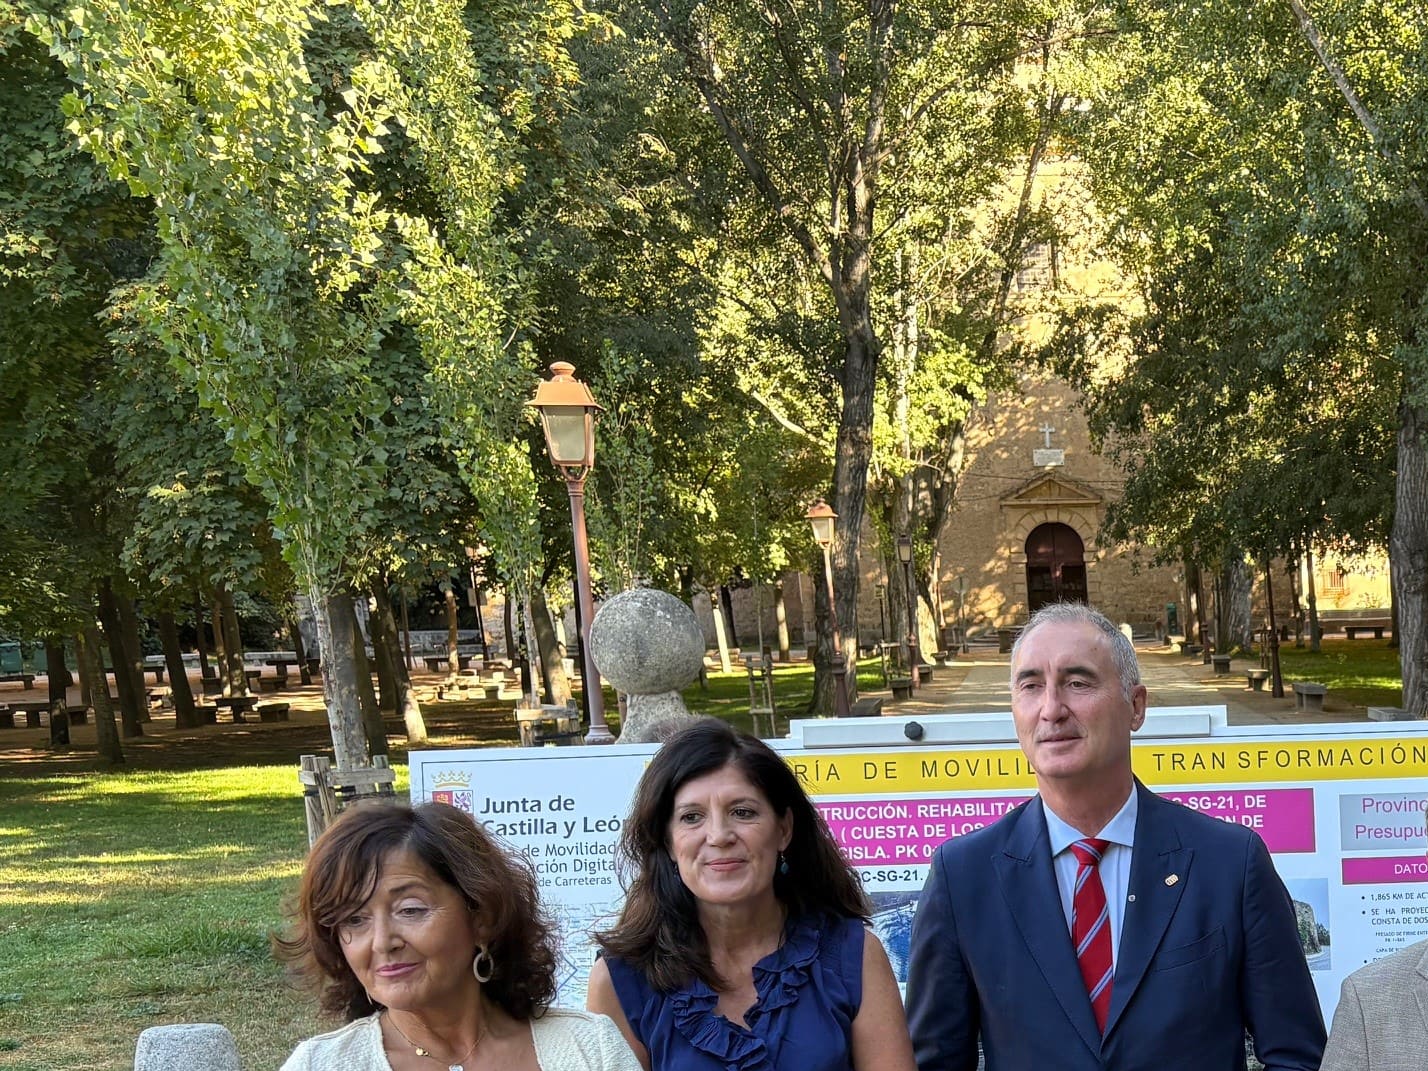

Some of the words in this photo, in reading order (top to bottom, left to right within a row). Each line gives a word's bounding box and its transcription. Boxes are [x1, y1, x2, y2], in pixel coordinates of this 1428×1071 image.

[864, 761, 897, 780] DE
[480, 797, 542, 814] Junta
[549, 795, 575, 812] de
[1244, 794, 1267, 808] DE
[563, 820, 576, 839] y
[851, 825, 919, 840] CUESTA
[923, 824, 947, 838] DE
[1241, 814, 1264, 828] DE
[1355, 824, 1428, 841] Presupu
[545, 841, 616, 857] Movilidad
[895, 845, 918, 858] PK
[573, 859, 617, 875] Digita
[539, 877, 551, 887] de
[555, 876, 612, 887] Carreteras
[1371, 893, 1391, 901] 1,865
[1405, 892, 1415, 900] DE
[1371, 908, 1380, 916] SE
[1371, 918, 1400, 926] CONSTA
[1402, 917, 1411, 925] DE
[1414, 916, 1428, 924] DOS
